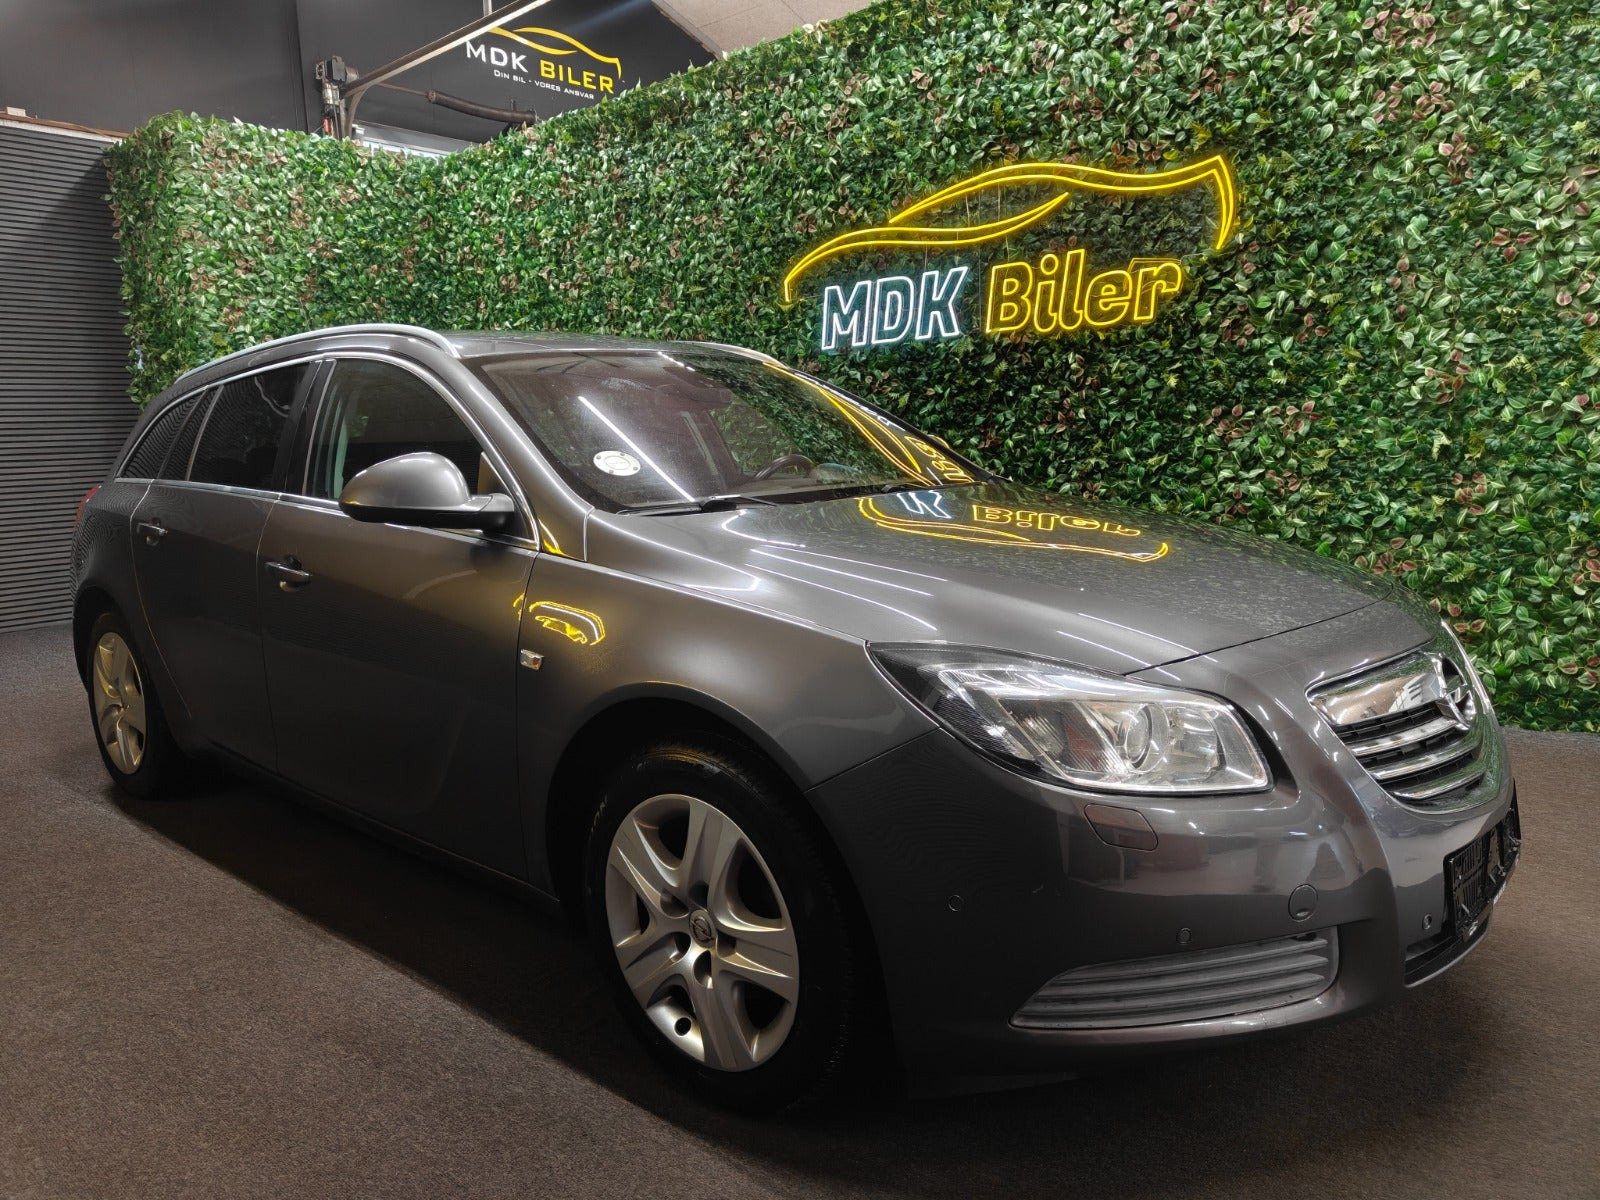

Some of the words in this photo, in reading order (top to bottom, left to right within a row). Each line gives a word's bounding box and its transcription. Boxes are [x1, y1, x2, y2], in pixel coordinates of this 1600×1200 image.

[466, 40, 528, 73] MDK
[539, 59, 614, 94] BILER
[512, 75, 526, 84] BIL
[534, 80, 561, 92] VORES
[563, 87, 595, 100] ANSVAR
[821, 265, 969, 351] MDK
[985, 248, 1183, 334] Biler
